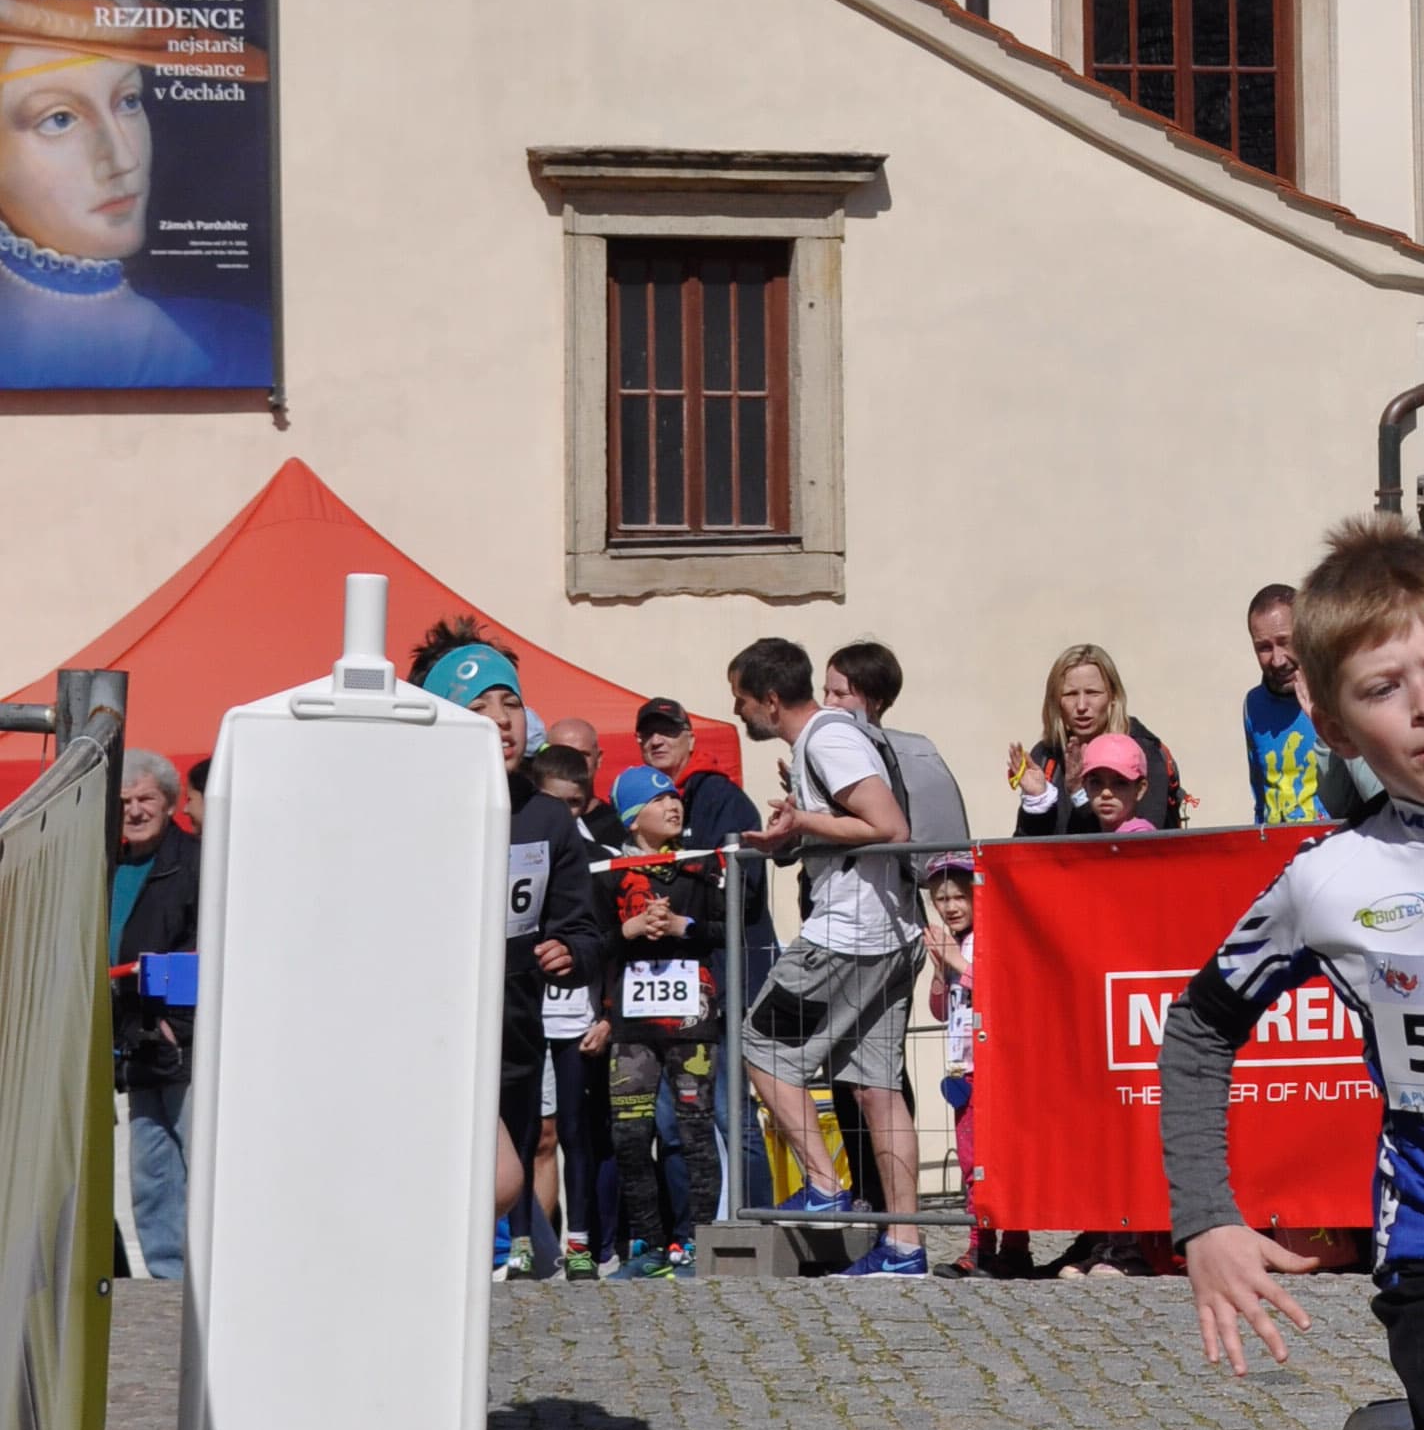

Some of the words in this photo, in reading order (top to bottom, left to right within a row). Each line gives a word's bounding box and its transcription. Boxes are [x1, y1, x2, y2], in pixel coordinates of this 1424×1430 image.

[94, 6, 245, 29] REZIDENCE
[168, 36, 245, 56] nejstarší
[155, 63, 245, 77] renesance
[154, 87, 166, 101] v
[170, 81, 245, 101] Čechách
[632, 980, 688, 1002] 2138
[1128, 987, 1364, 1046] NREN
[1116, 1085, 1161, 1105] THE
[1267, 1082, 1298, 1102] OF
[1305, 1080, 1379, 1100] NUTRI
